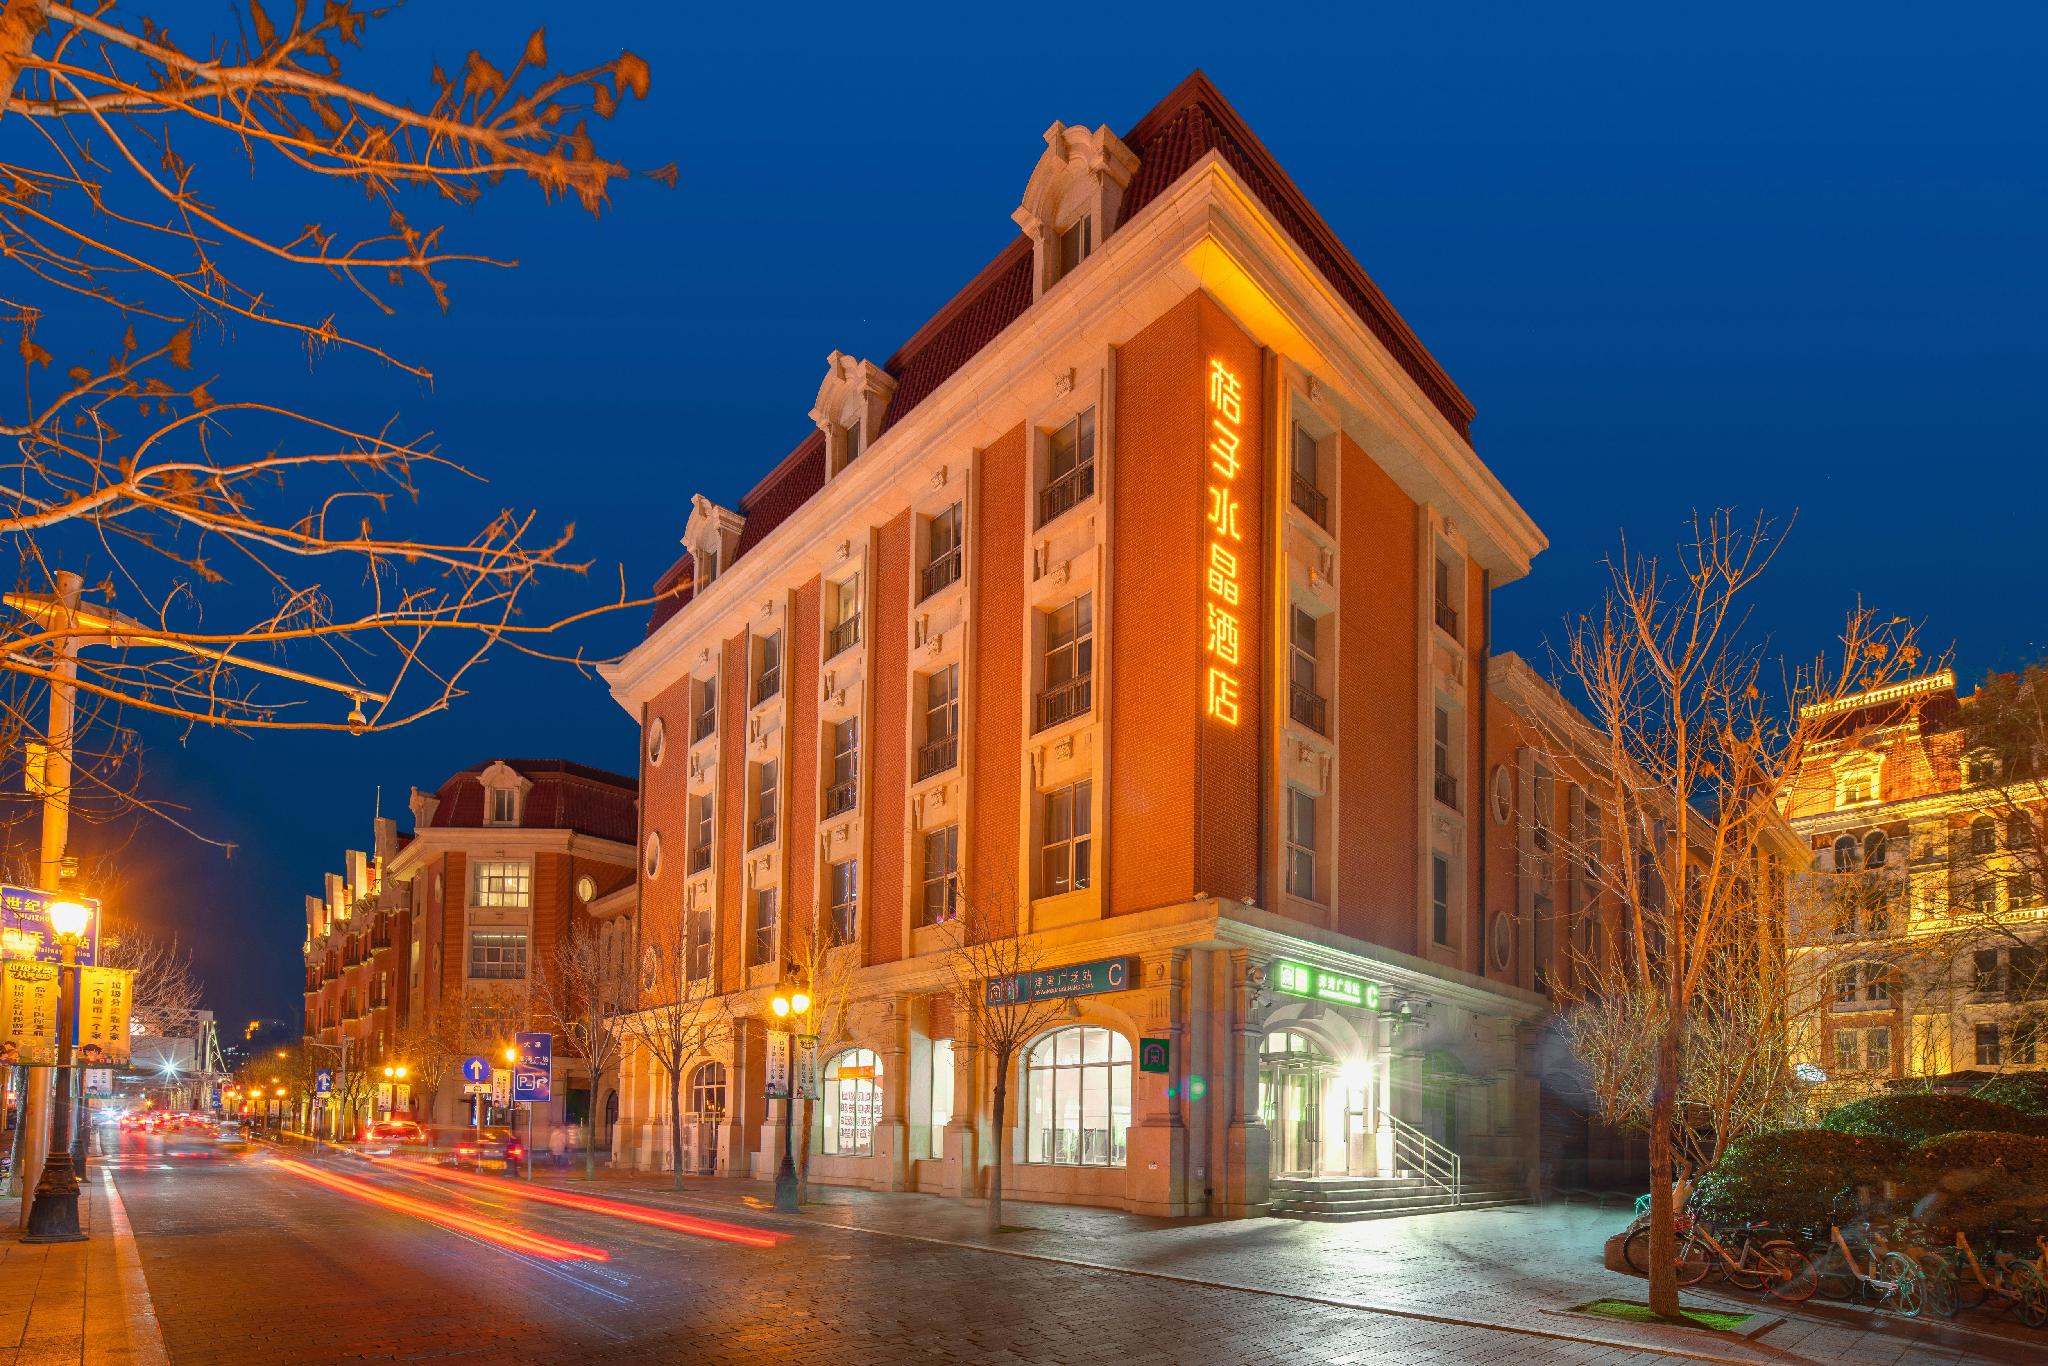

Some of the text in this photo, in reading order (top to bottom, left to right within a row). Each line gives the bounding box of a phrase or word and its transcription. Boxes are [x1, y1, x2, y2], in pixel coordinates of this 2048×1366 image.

[1208, 359, 1241, 726] 桔子水晶酒店
[1108, 963, 1122, 986] C
[1366, 985, 1378, 1008] C
[519, 1076, 528, 1087] P
